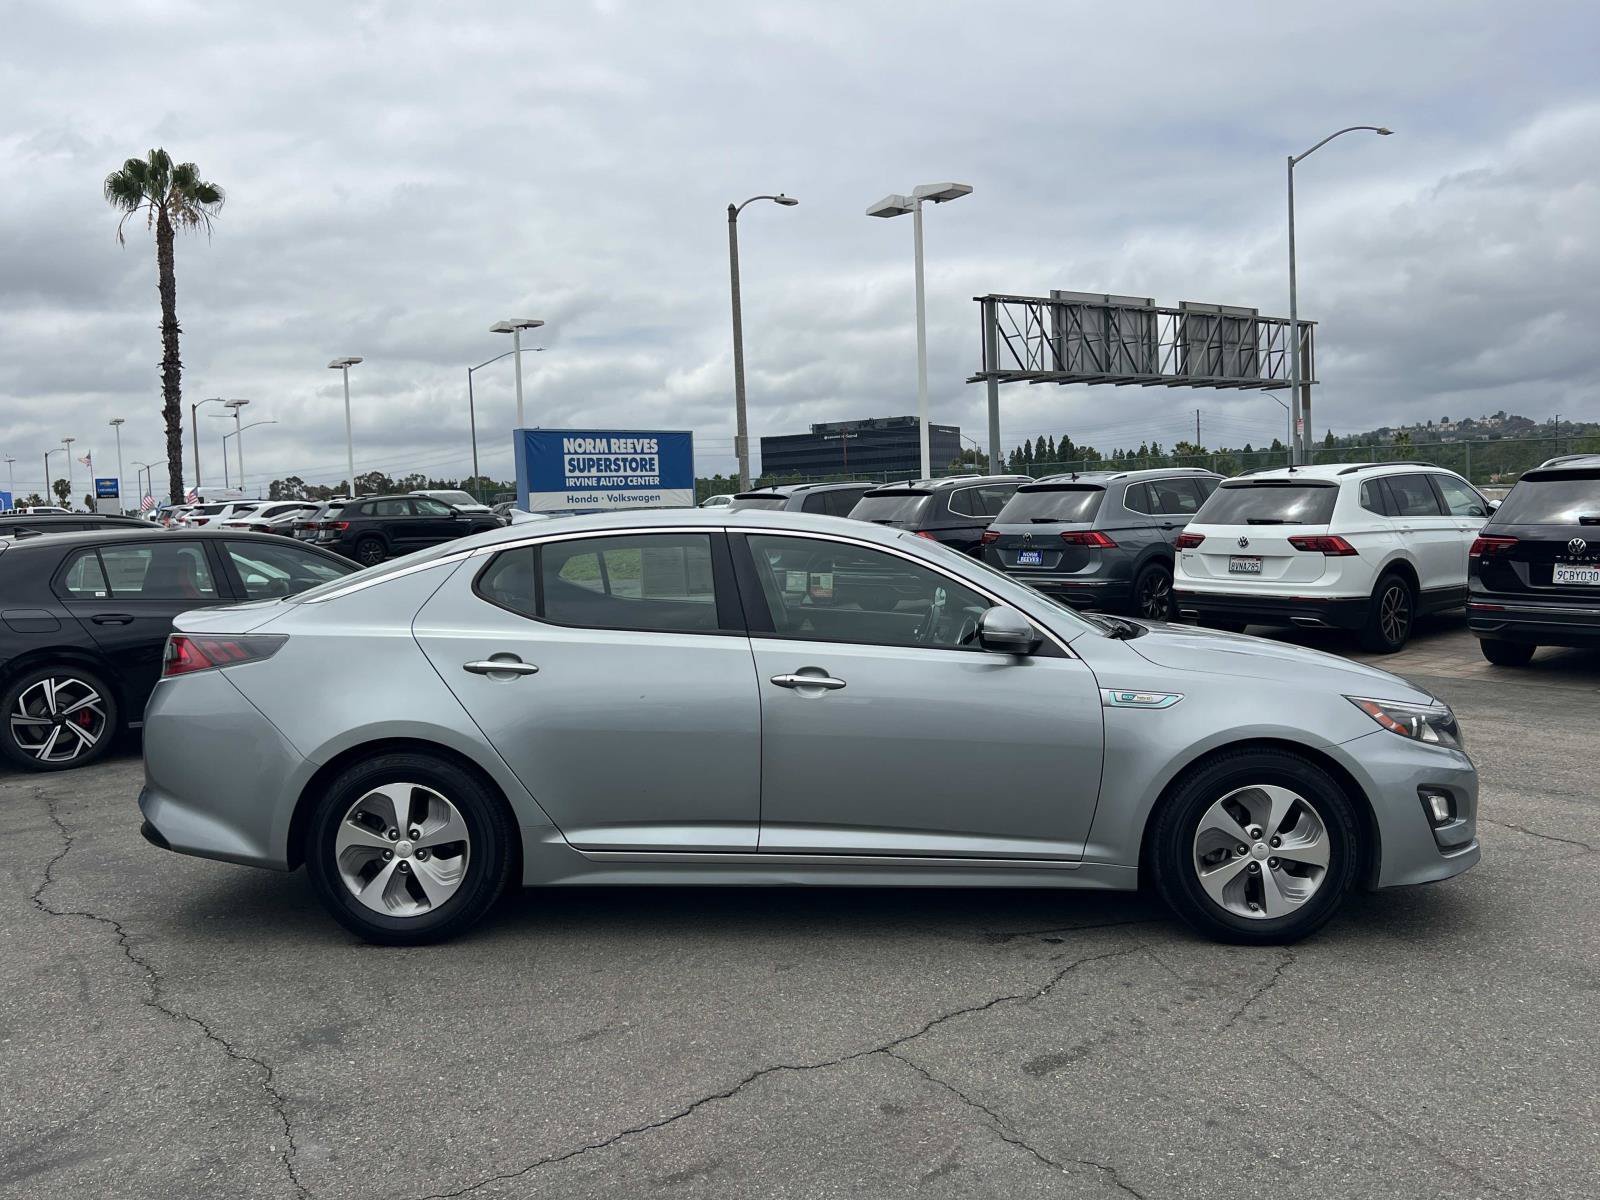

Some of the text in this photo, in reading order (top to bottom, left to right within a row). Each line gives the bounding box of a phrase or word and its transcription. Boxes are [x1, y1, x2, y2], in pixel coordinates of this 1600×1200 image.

[563, 438, 658, 454] NORM REEVES
[568, 457, 656, 473] SUPERSTORE
[565, 476, 660, 487] IRVINE AUTO CENTER
[567, 493, 661, 503] Honda Volkswagen
[1557, 570, 1599, 581] 9CBY030
